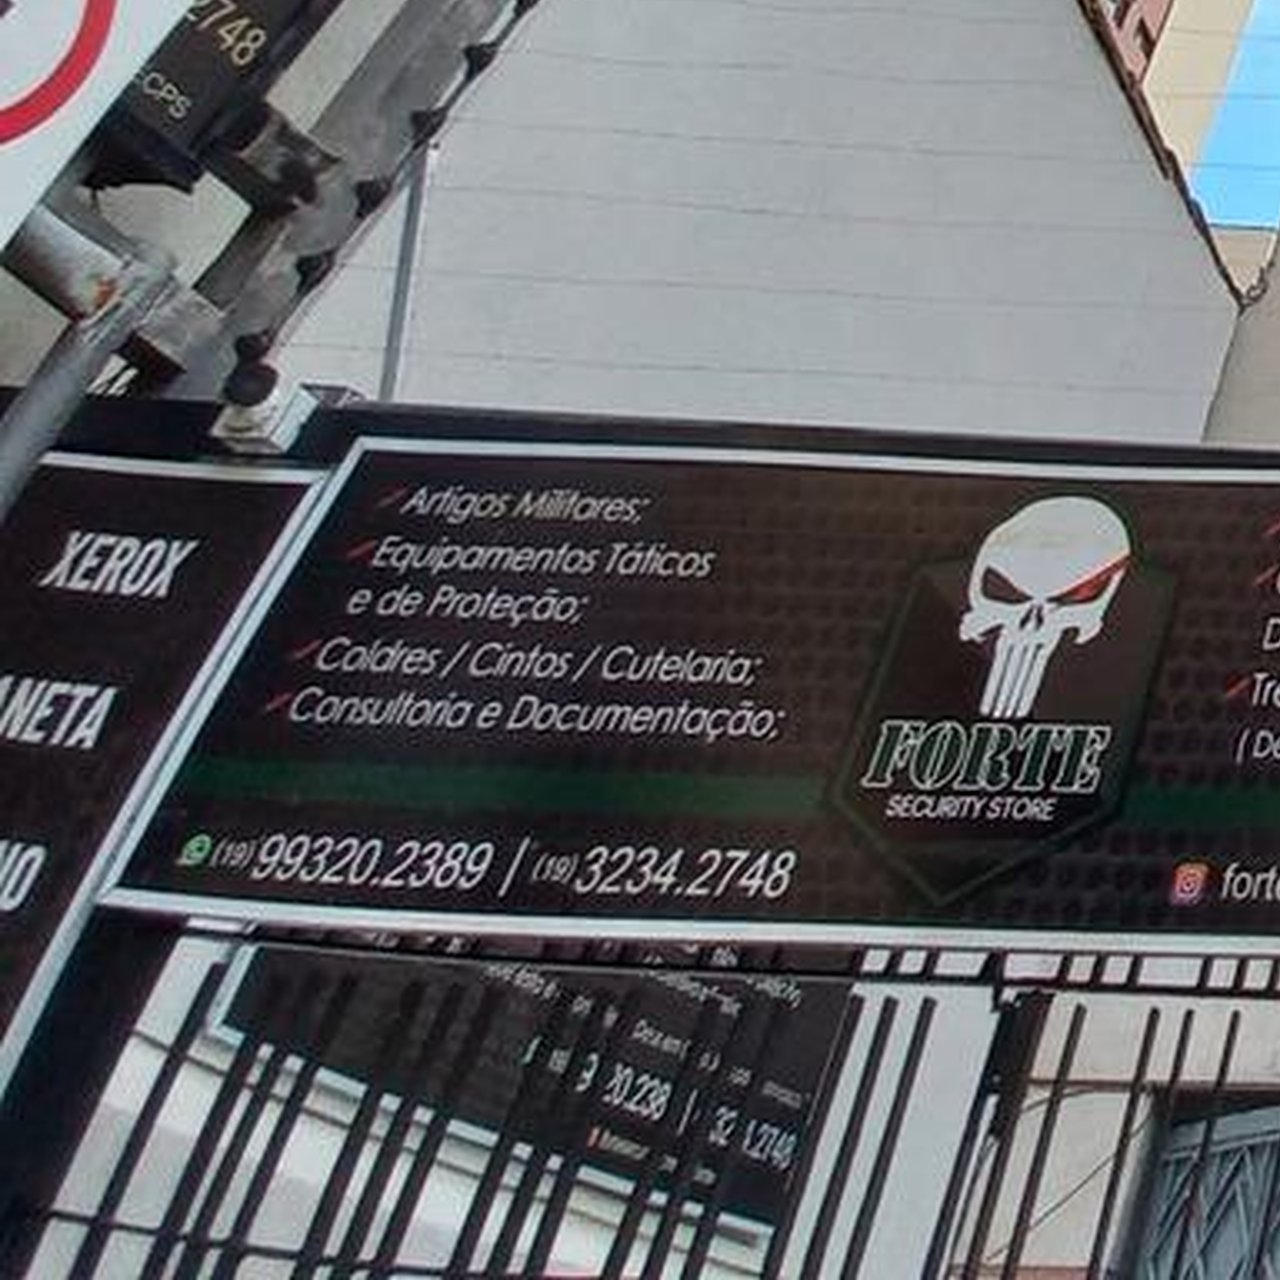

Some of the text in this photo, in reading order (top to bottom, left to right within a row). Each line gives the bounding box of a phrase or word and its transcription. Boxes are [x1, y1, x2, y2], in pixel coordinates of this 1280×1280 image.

[400, 485, 508, 524] Artigos
[39, 529, 199, 600] XEROX
[371, 535, 718, 578] Equipamentos Táticos
[345, 584, 590, 626] e de Proteção;
[315, 635, 764, 688] Coldres / Cintos / Cutelaria;
[288, 686, 786, 742] Consultoria e Documentação;
[861, 719, 1111, 795] FORTE
[885, 794, 1057, 821] SECURITY STORE
